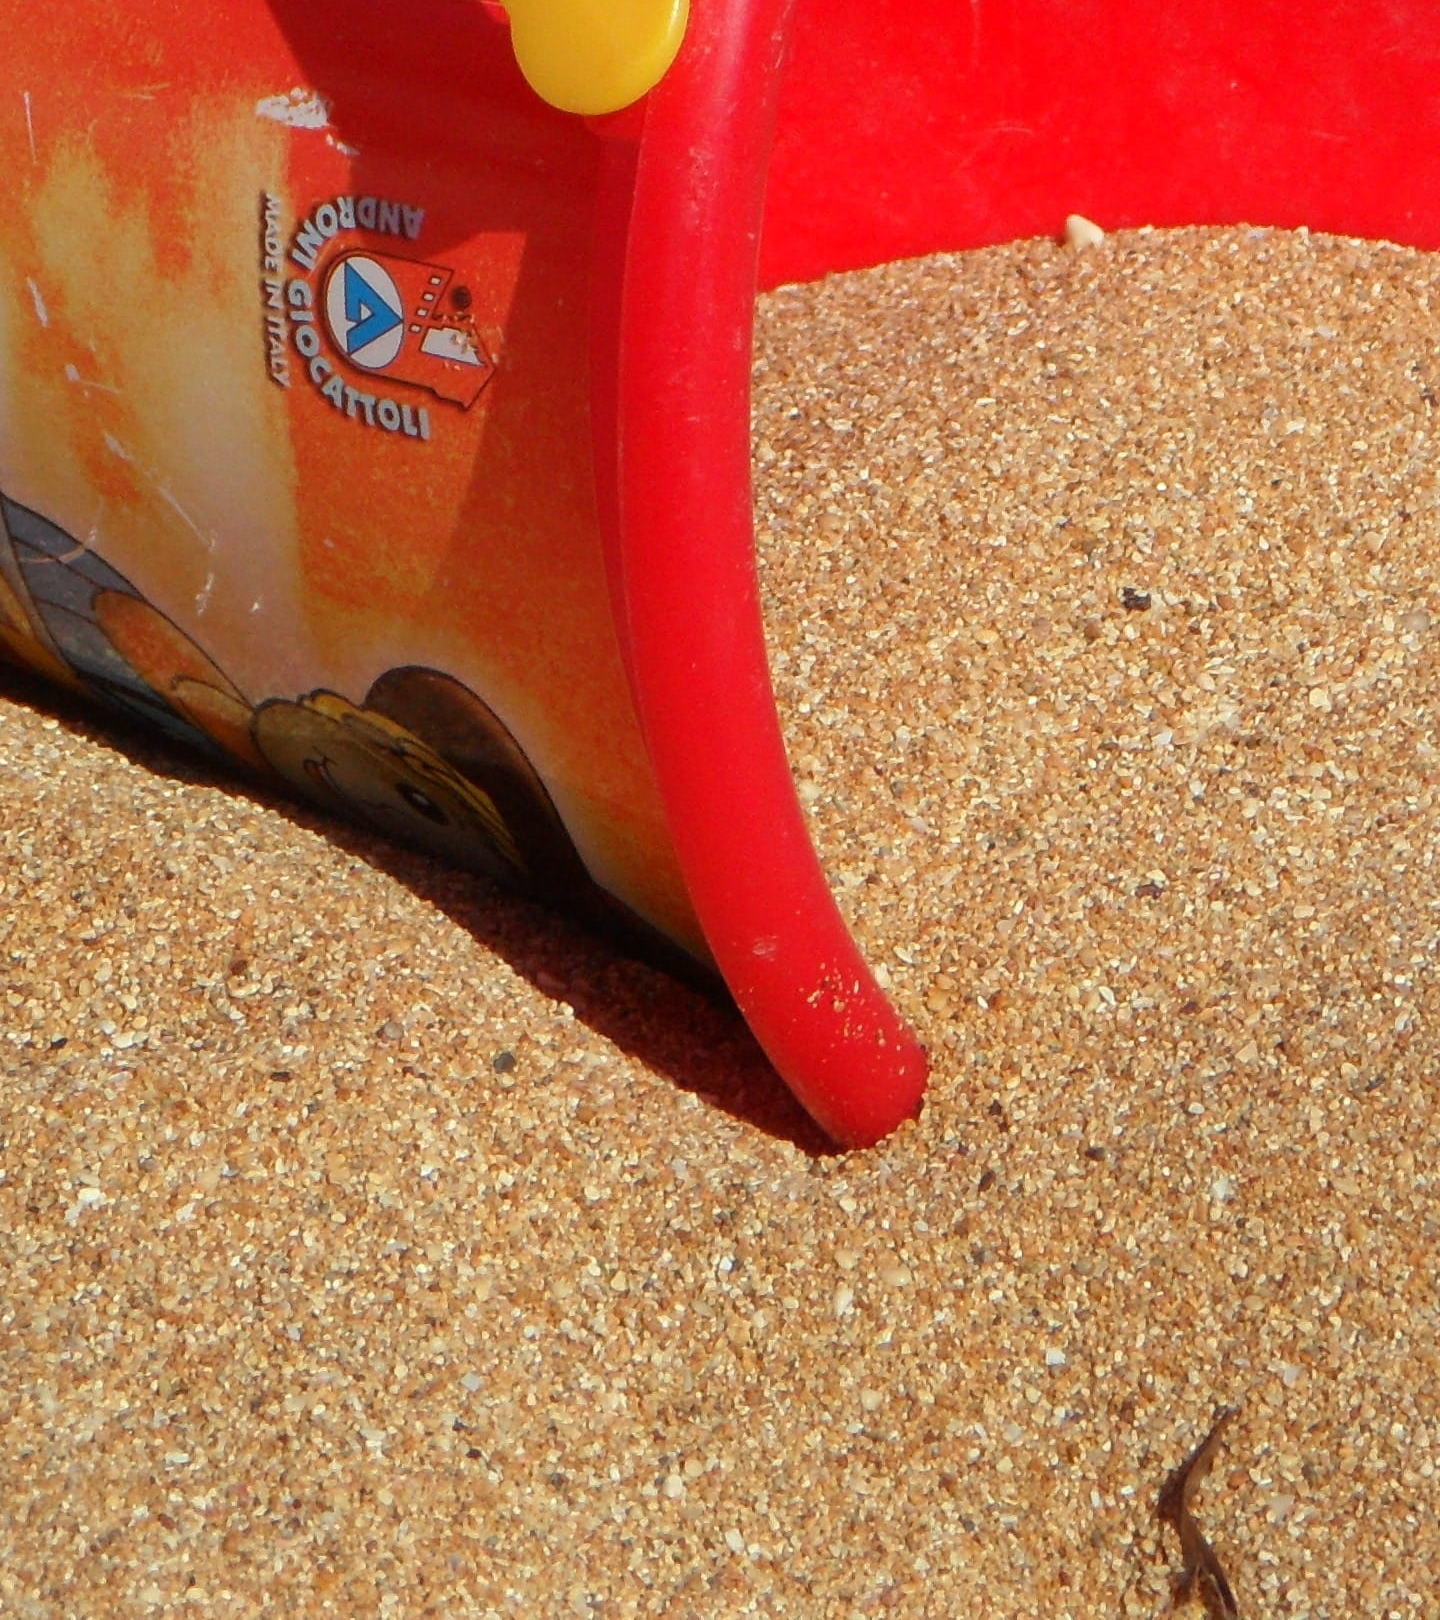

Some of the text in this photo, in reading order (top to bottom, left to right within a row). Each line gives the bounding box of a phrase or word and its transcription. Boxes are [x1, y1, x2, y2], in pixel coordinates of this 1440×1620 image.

[262, 191, 290, 387] MADE IN ITALY
[288, 196, 431, 439] ANDRONI GIOCATTOLI
